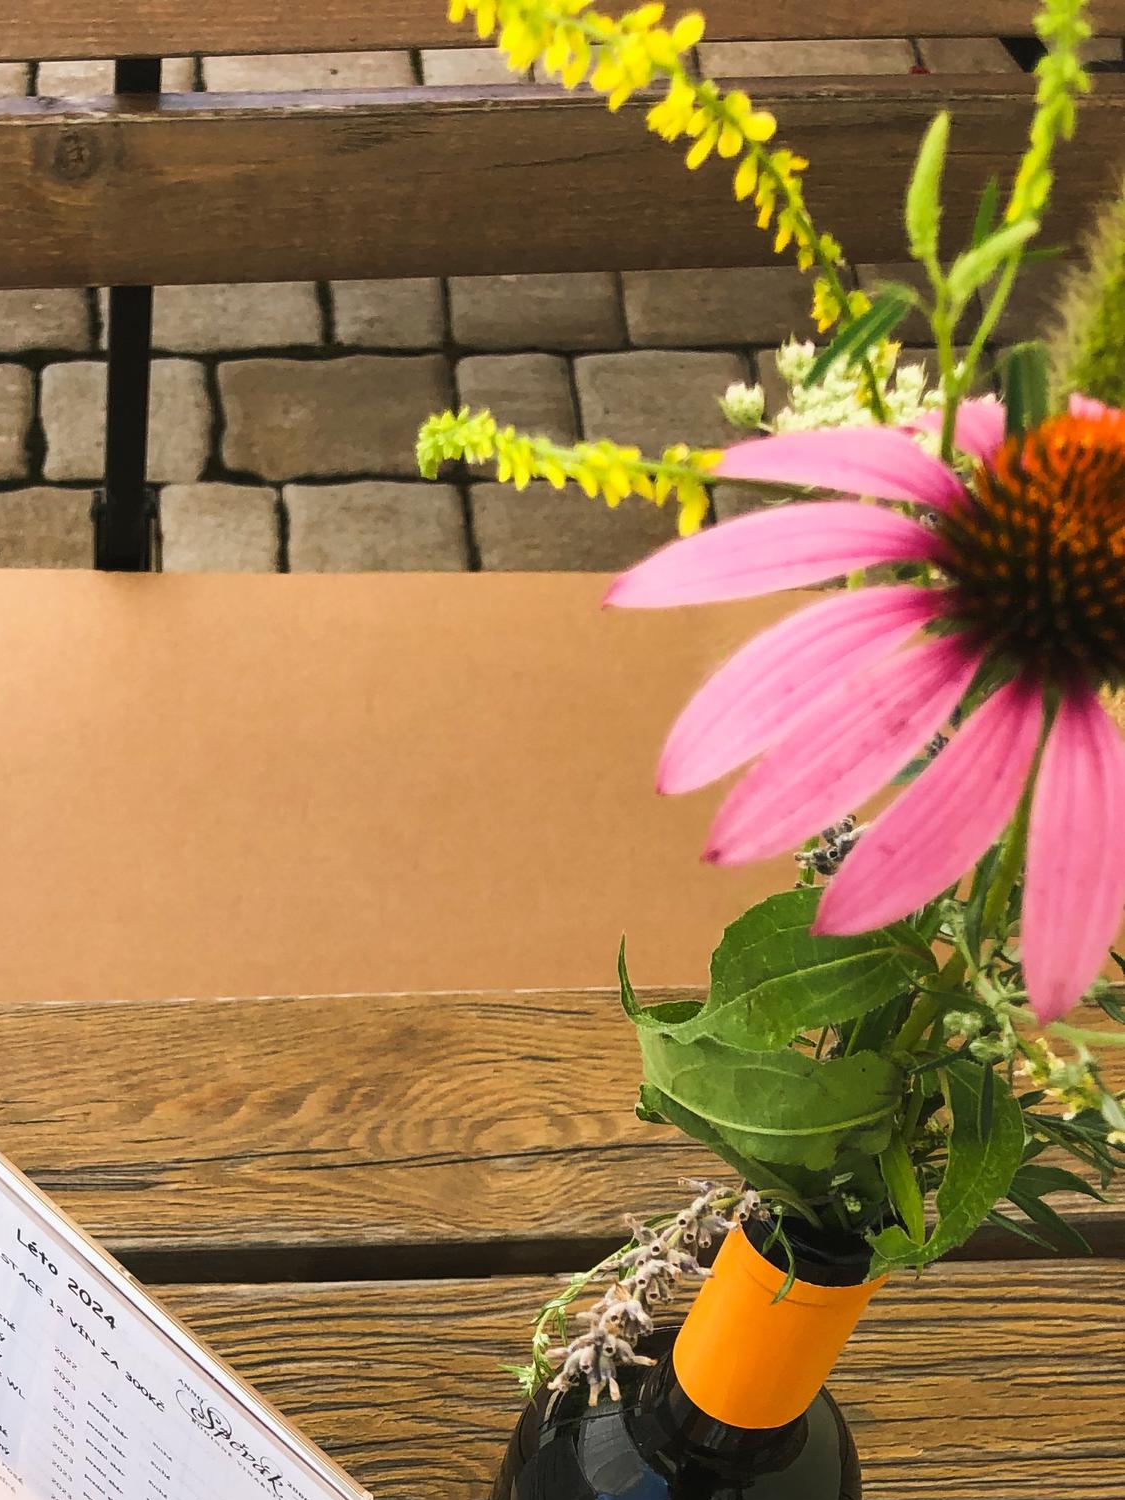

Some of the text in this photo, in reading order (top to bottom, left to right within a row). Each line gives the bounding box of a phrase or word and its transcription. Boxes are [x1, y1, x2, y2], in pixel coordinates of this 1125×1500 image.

[16, 1227, 117, 1330] Léto 2024
[49, 1298, 65, 1318] 12
[69, 1317, 96, 1347] VÍN
[100, 1347, 120, 1370] ZA
[124, 1371, 166, 1412] 300KČ
[55, 1346, 77, 1371] 2022
[7, 1377, 25, 1399] WL
